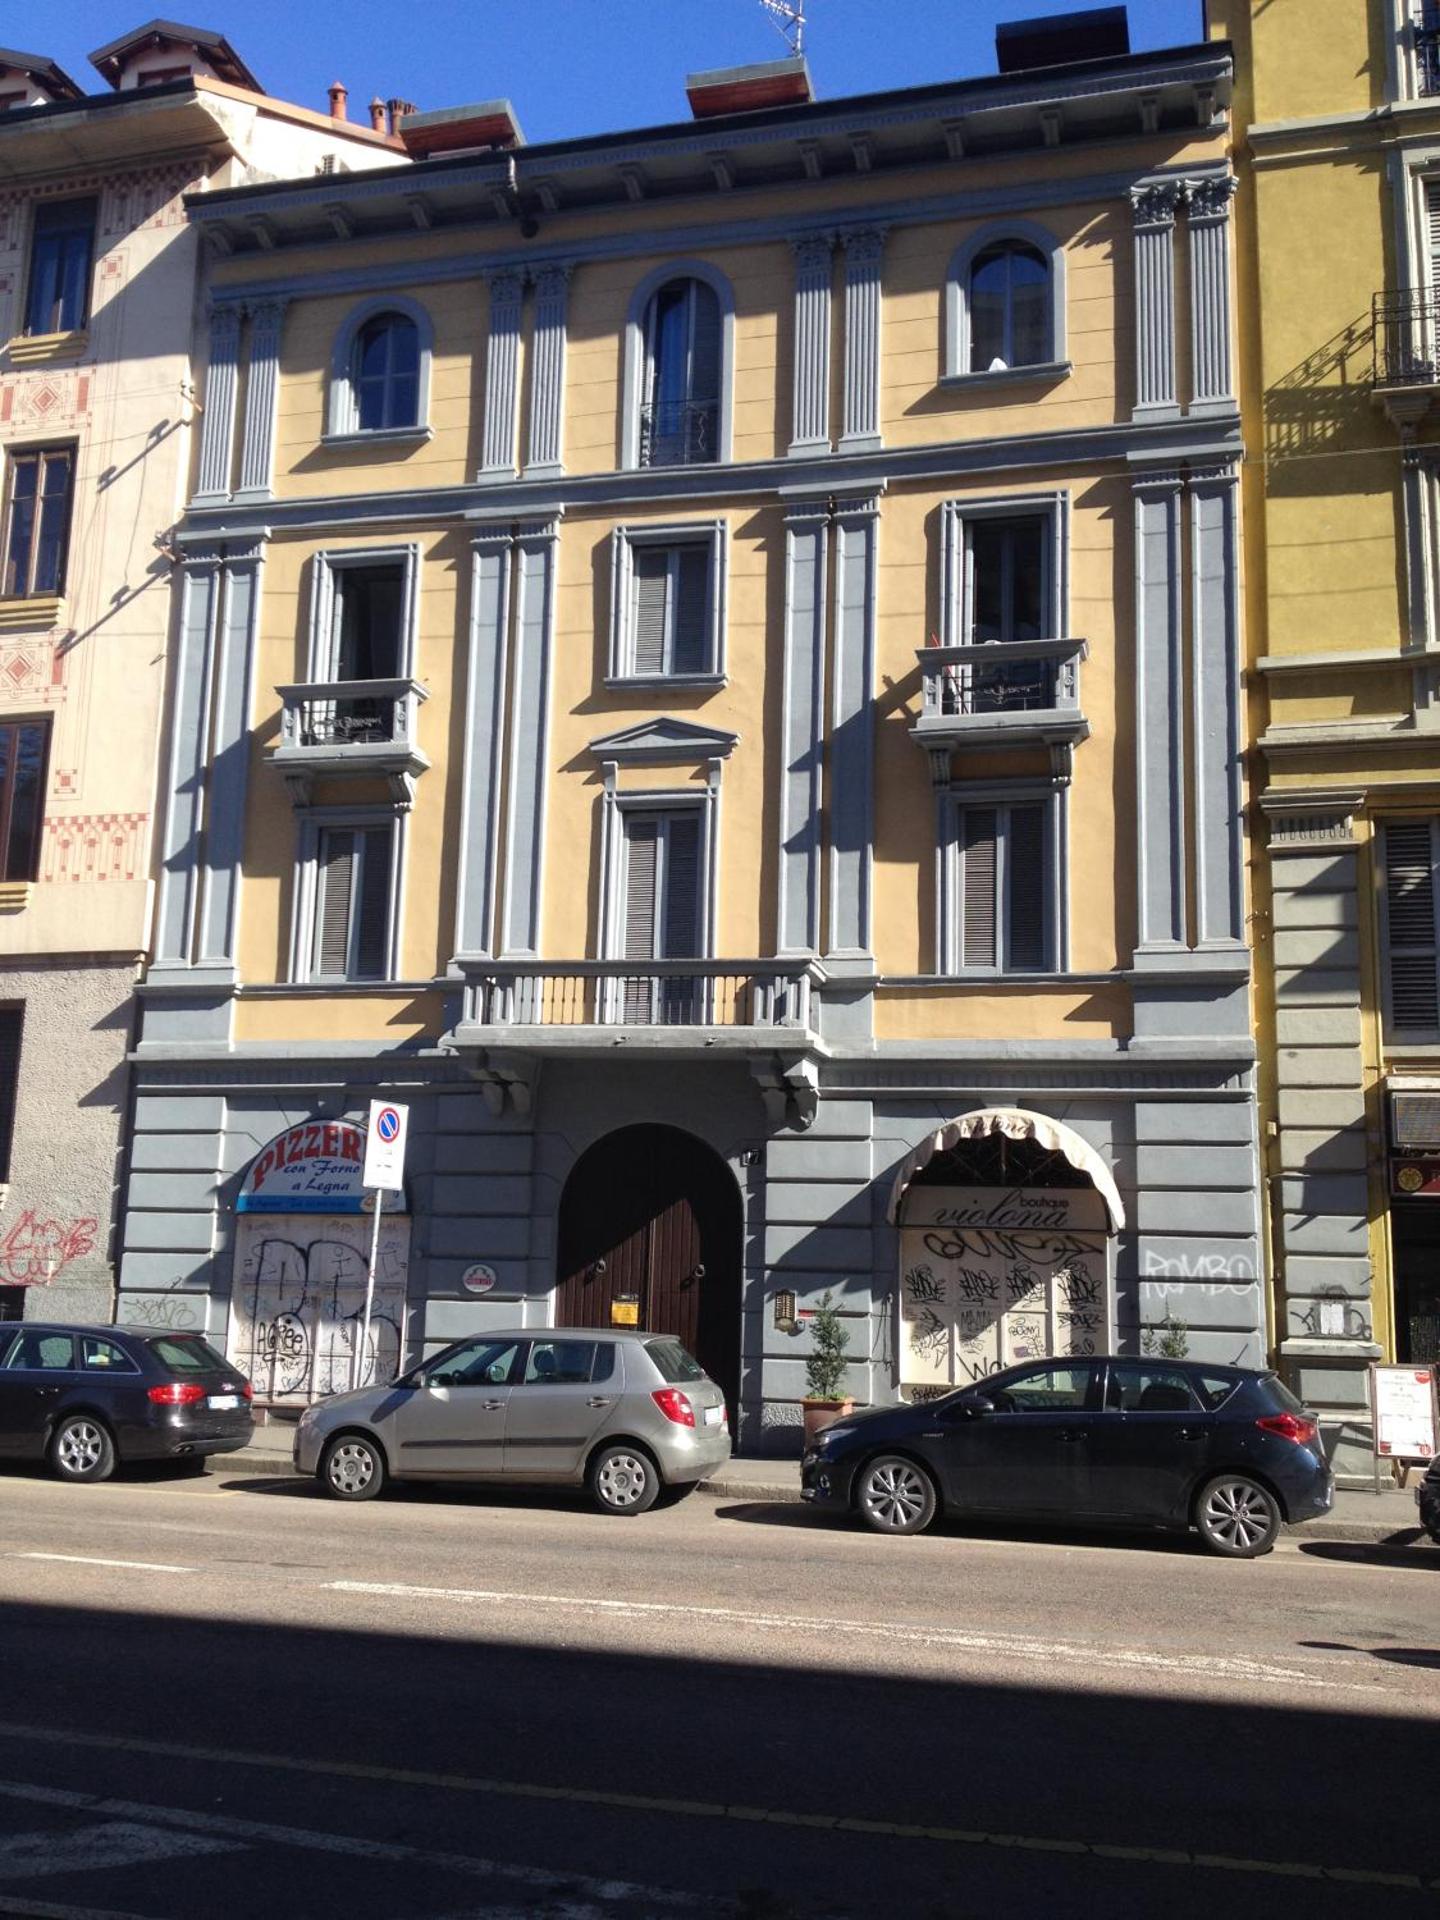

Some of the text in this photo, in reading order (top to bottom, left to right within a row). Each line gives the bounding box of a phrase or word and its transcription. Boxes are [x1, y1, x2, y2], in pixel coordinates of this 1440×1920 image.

[252, 1125, 368, 1193] PIZZER
[283, 1165, 306, 1174] con
[311, 1159, 361, 1176] Forno
[291, 1177, 350, 1195] a Legna
